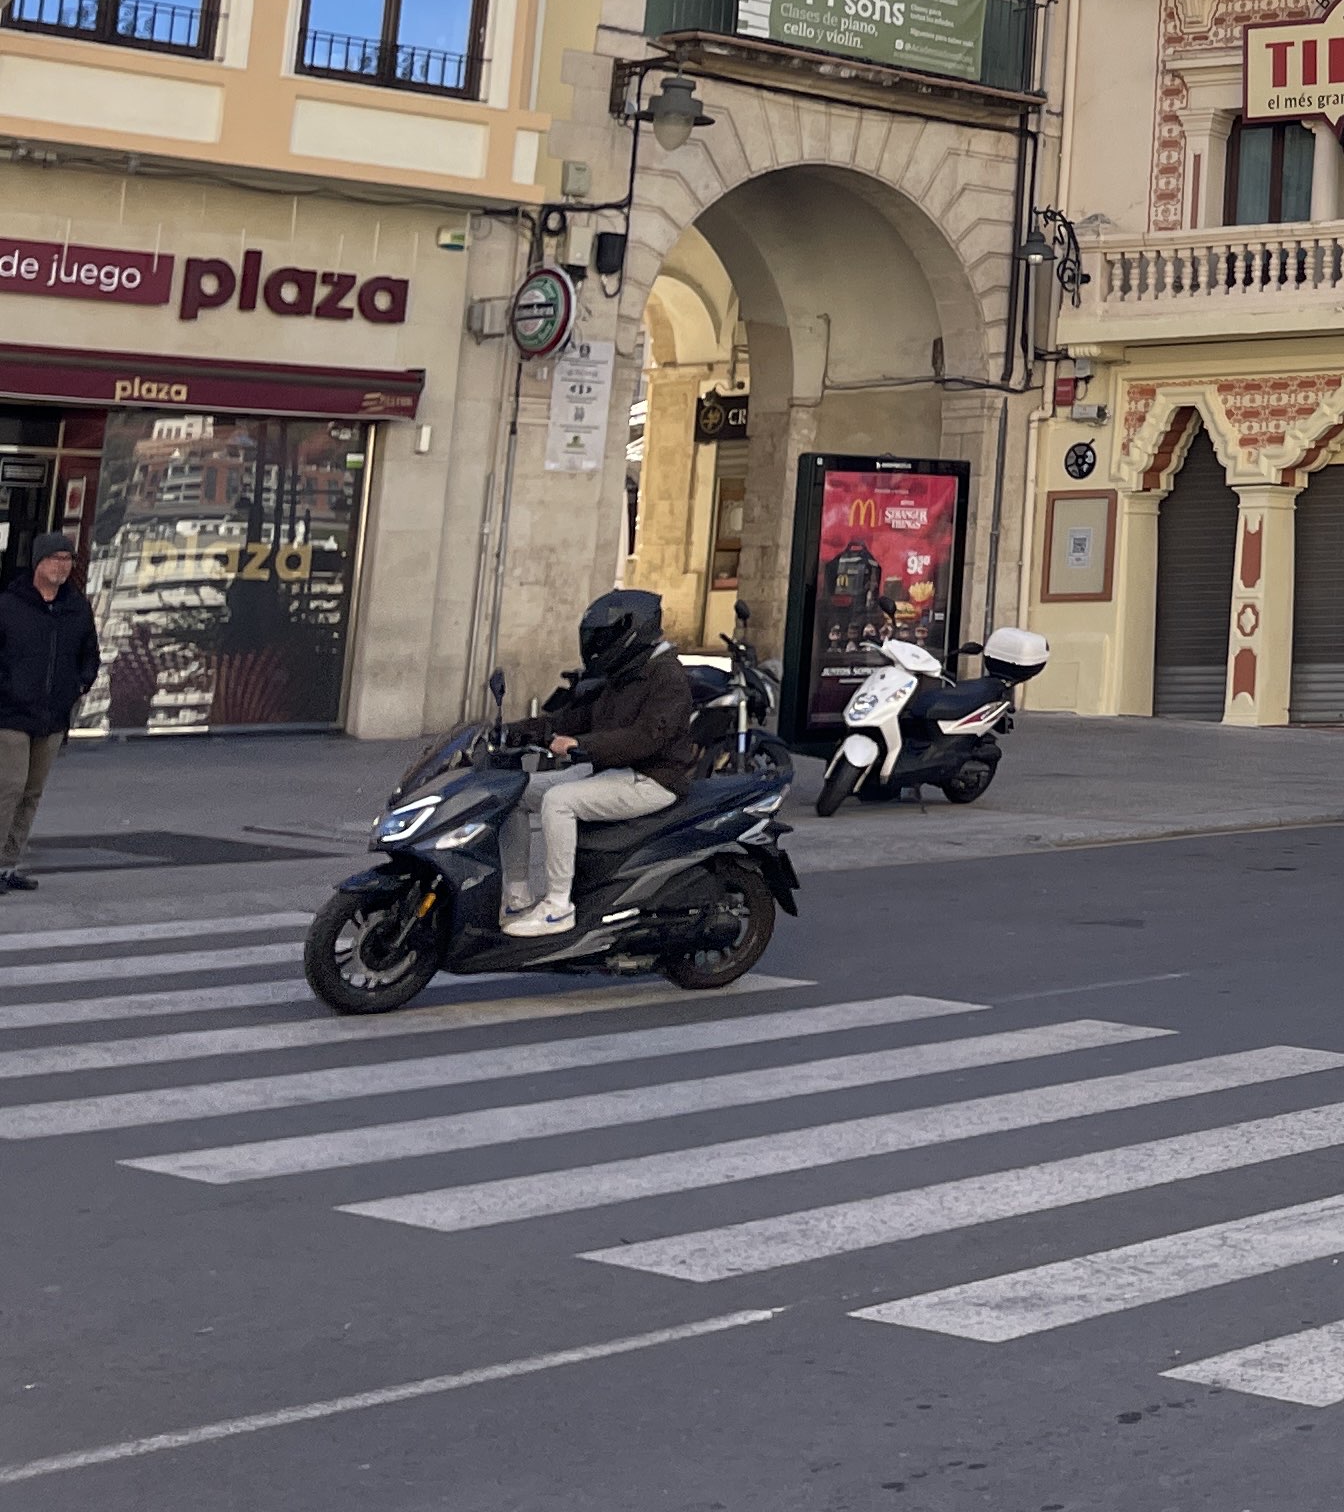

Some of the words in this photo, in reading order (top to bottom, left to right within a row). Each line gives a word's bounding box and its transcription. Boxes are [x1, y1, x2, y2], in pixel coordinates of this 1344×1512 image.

[780, 2, 820, 23] Clases
[823, 11, 839, 27] de
[840, 16, 878, 37] piano,
[784, 22, 814, 38] cello
[816, 29, 825, 44] y
[1268, 94, 1280, 110] el
[1285, 92, 1313, 108] més
[0, 249, 39, 280] de
[47, 253, 141, 292] juego
[179, 249, 410, 324] plaza
[114, 376, 188, 402] plaza
[137, 535, 312, 592] plaza
